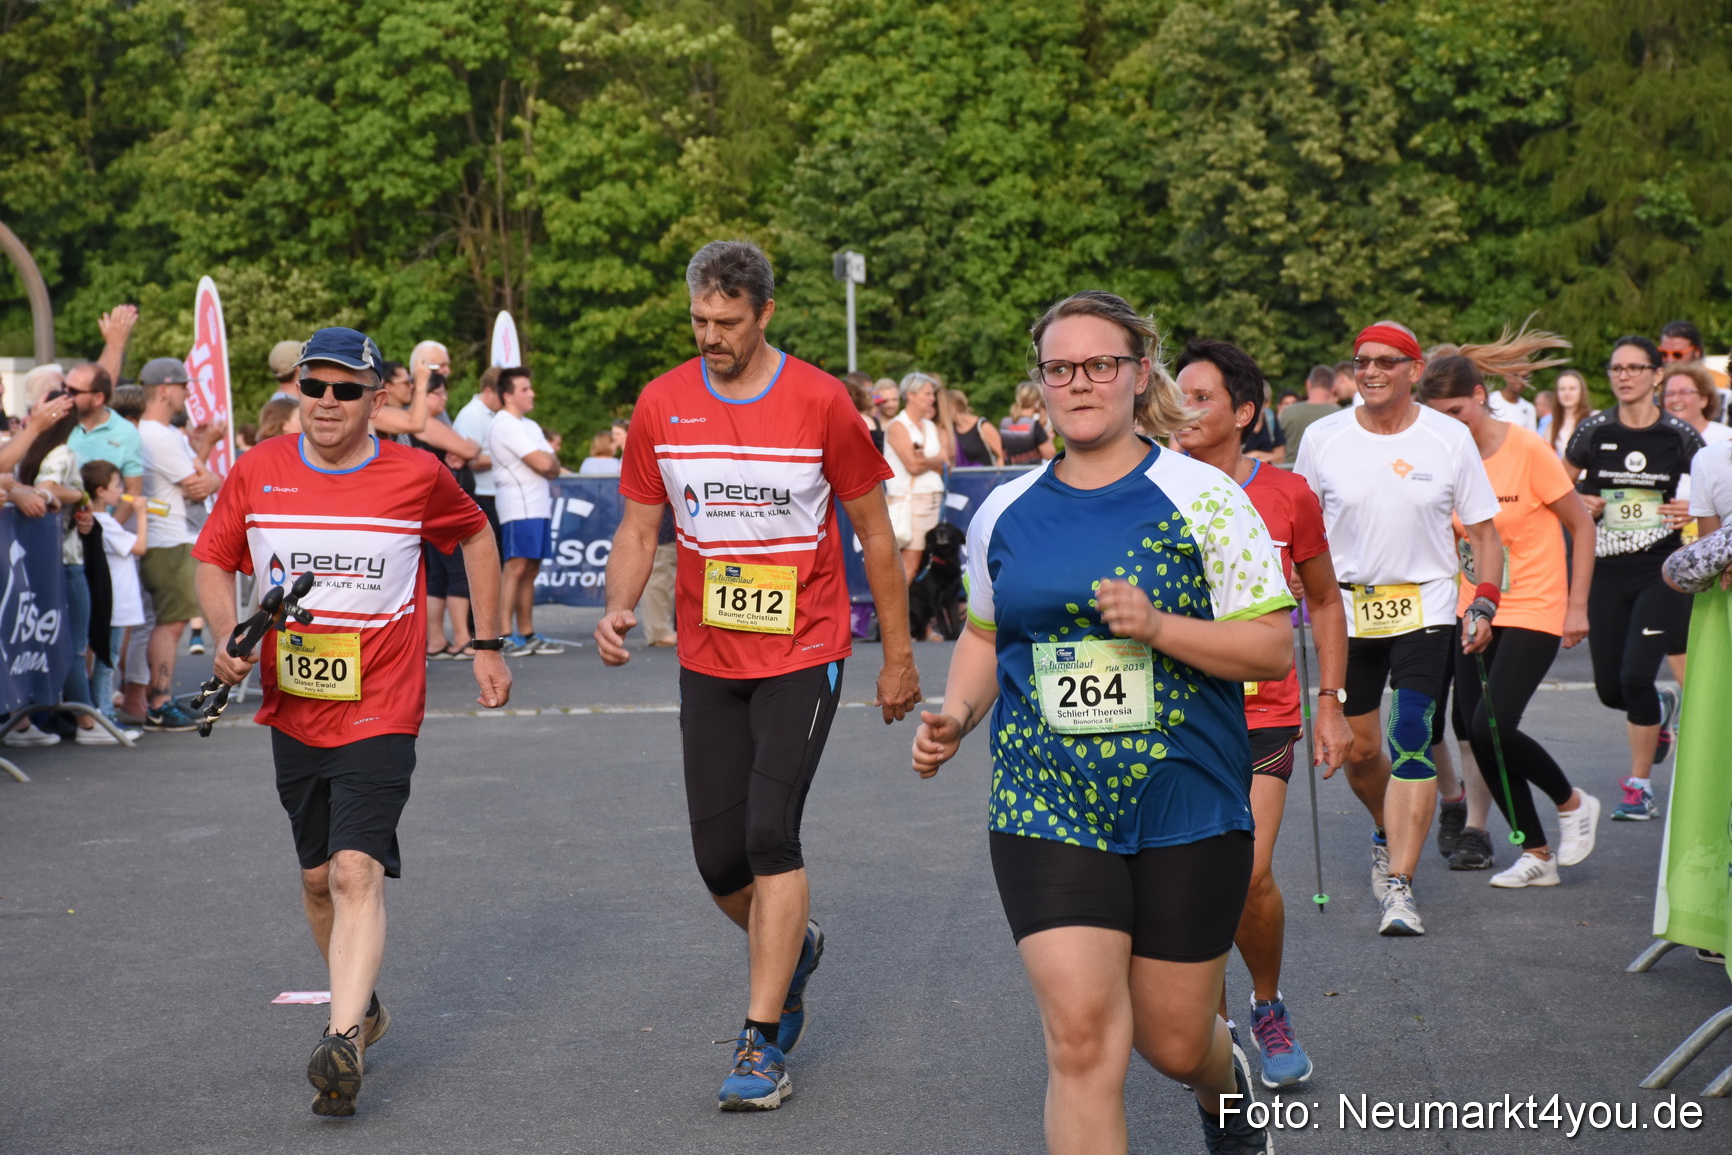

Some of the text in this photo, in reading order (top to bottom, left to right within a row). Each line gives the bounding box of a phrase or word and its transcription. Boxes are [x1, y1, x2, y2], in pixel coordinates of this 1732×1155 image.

[703, 482, 790, 506] Petry
[705, 508, 792, 518] WÄRME KÄLTE KLIMA
[1620, 503, 1642, 520] 98
[290, 552, 386, 580] Petry
[356, 582, 382, 592] KLIMA
[715, 585, 784, 615] 1812
[1361, 598, 1412, 621] 1338
[718, 610, 778, 622] Baumer Christian
[736, 618, 749, 626] Petry
[285, 653, 347, 682] 1820
[1049, 659, 1094, 670] firmenlauf
[1122, 663, 1145, 672] 2019
[293, 678, 336, 689] Glaser Ewald
[1057, 673, 1126, 708] 264
[1057, 707, 1132, 719] Schlierf Theresia
[1073, 718, 1103, 726] Bionorica
